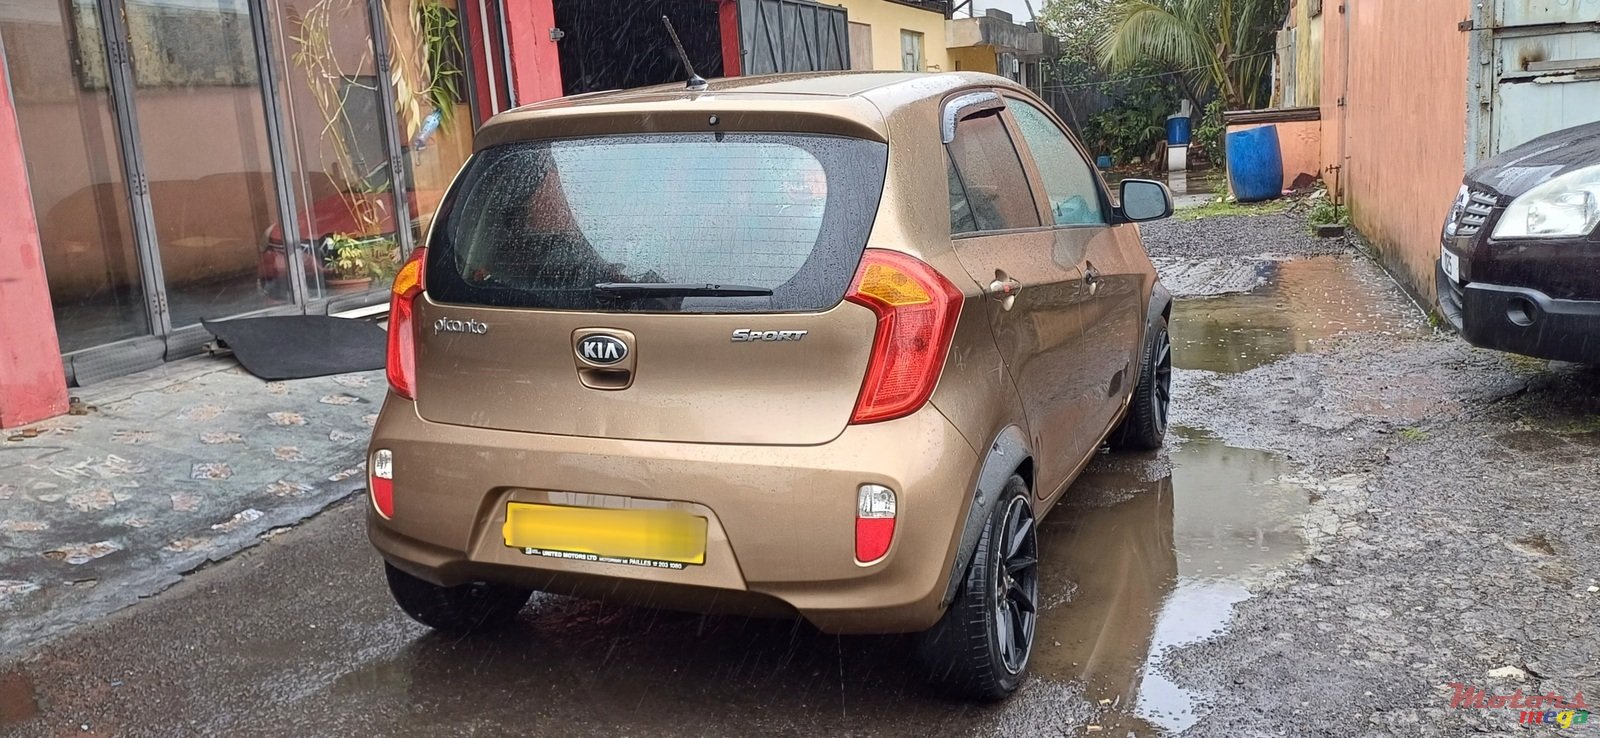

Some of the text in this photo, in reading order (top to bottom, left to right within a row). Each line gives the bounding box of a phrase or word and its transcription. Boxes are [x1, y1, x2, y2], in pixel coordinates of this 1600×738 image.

[434, 317, 487, 335] picanto
[731, 328, 808, 342] SPORT
[584, 341, 619, 359] KIA
[542, 550, 562, 558] UNITED
[562, 552, 586, 560] MOTORS
